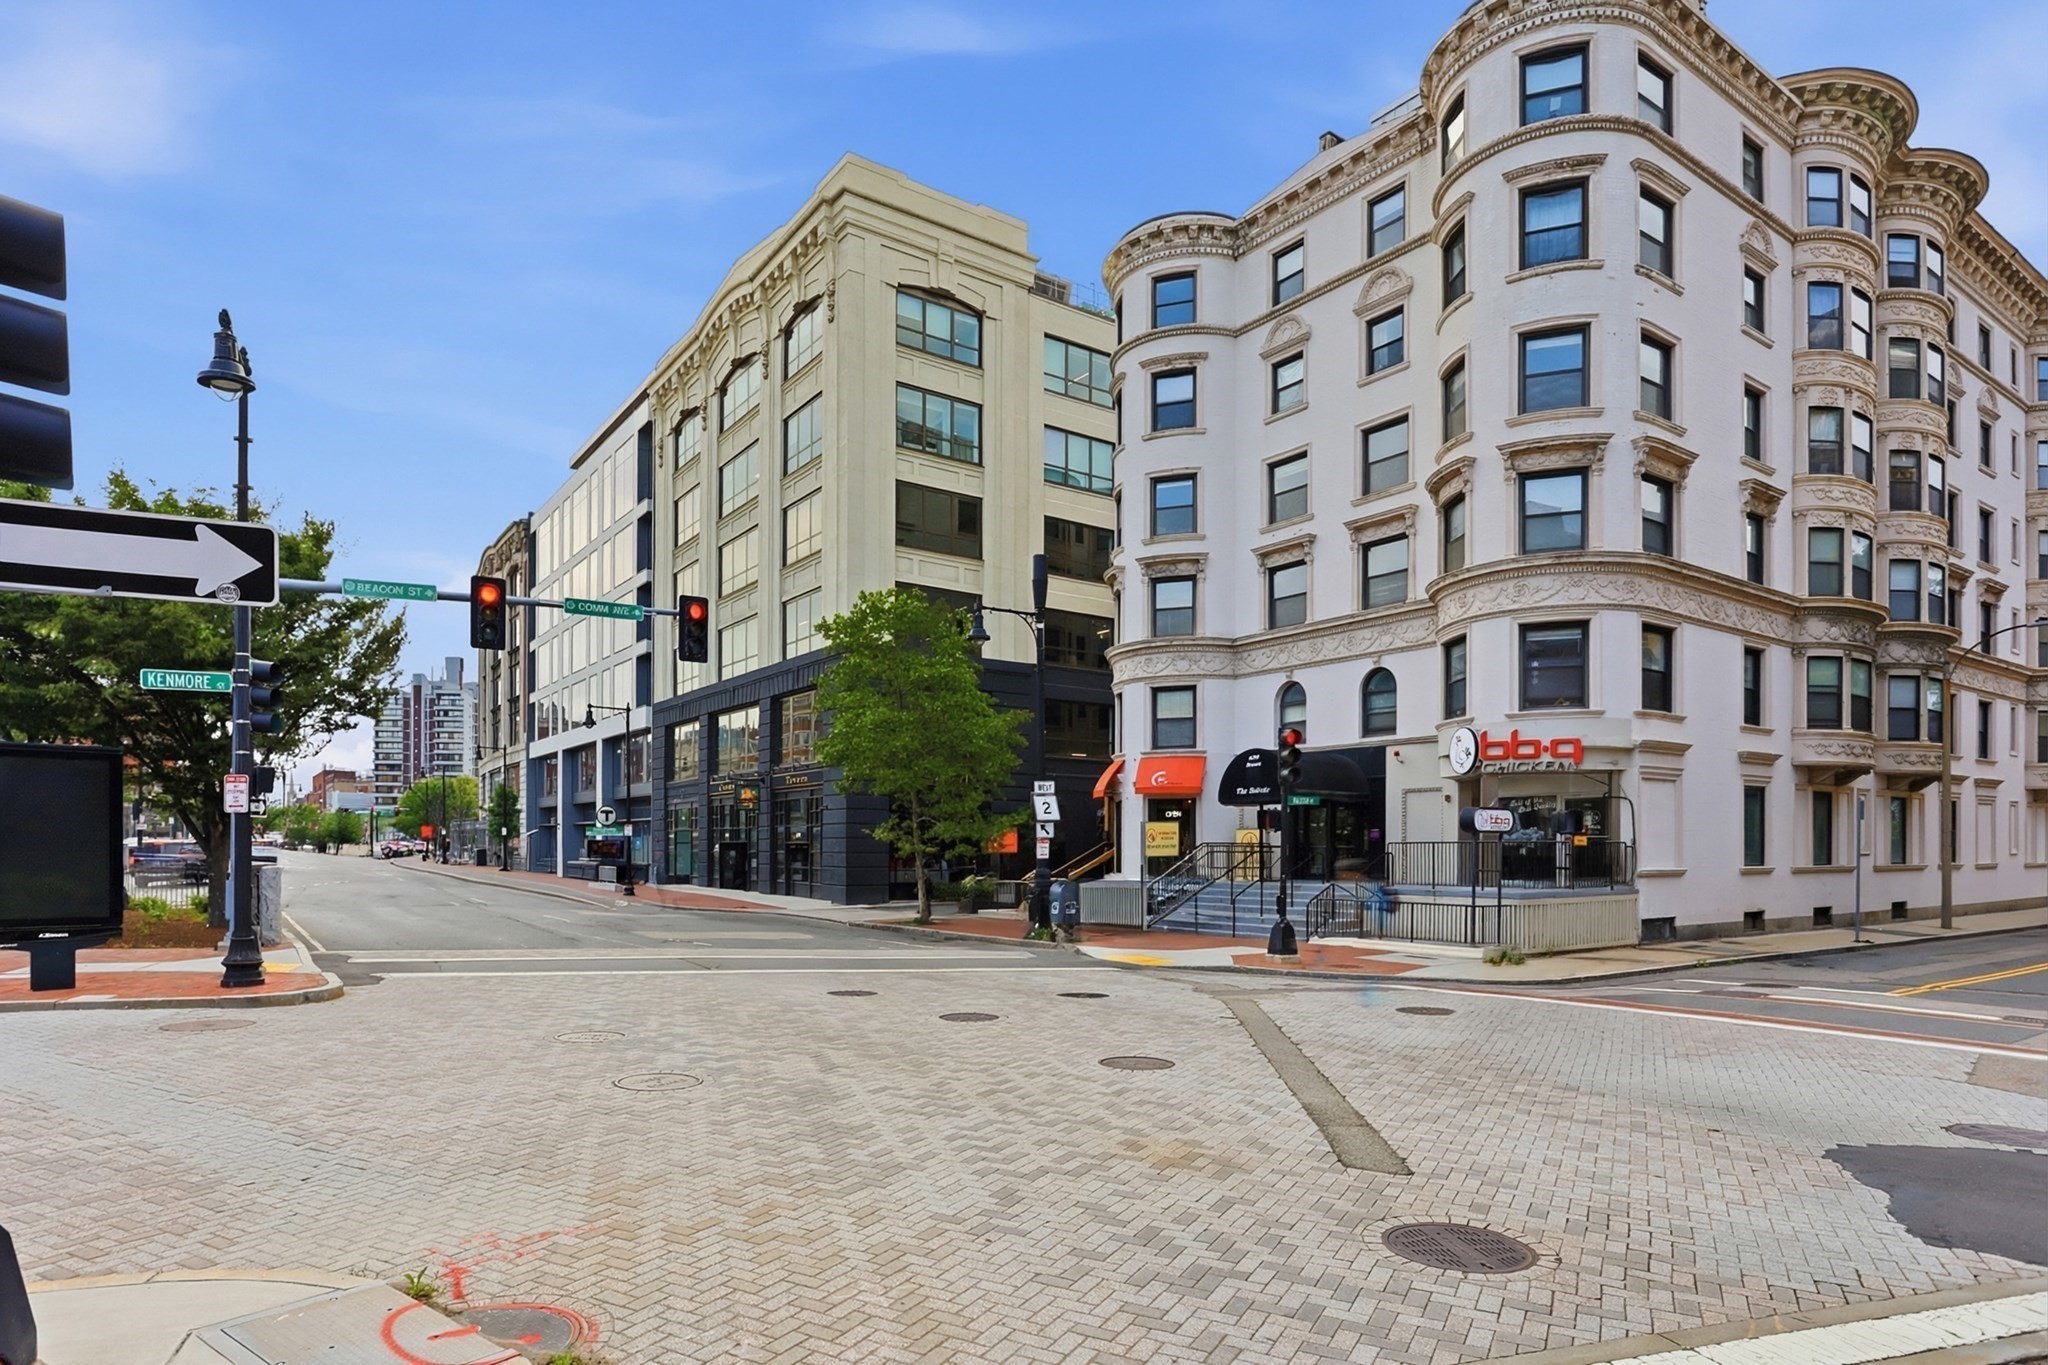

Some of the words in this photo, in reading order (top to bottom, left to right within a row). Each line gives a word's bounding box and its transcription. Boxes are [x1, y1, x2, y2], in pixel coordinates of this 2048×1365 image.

[356, 583, 404, 595] BEACON
[408, 586, 423, 597] ST
[578, 602, 609, 614] COMM
[147, 671, 212, 689] KENMORE
[1042, 801, 1052, 815] 2
[600, 810, 614, 822] T
